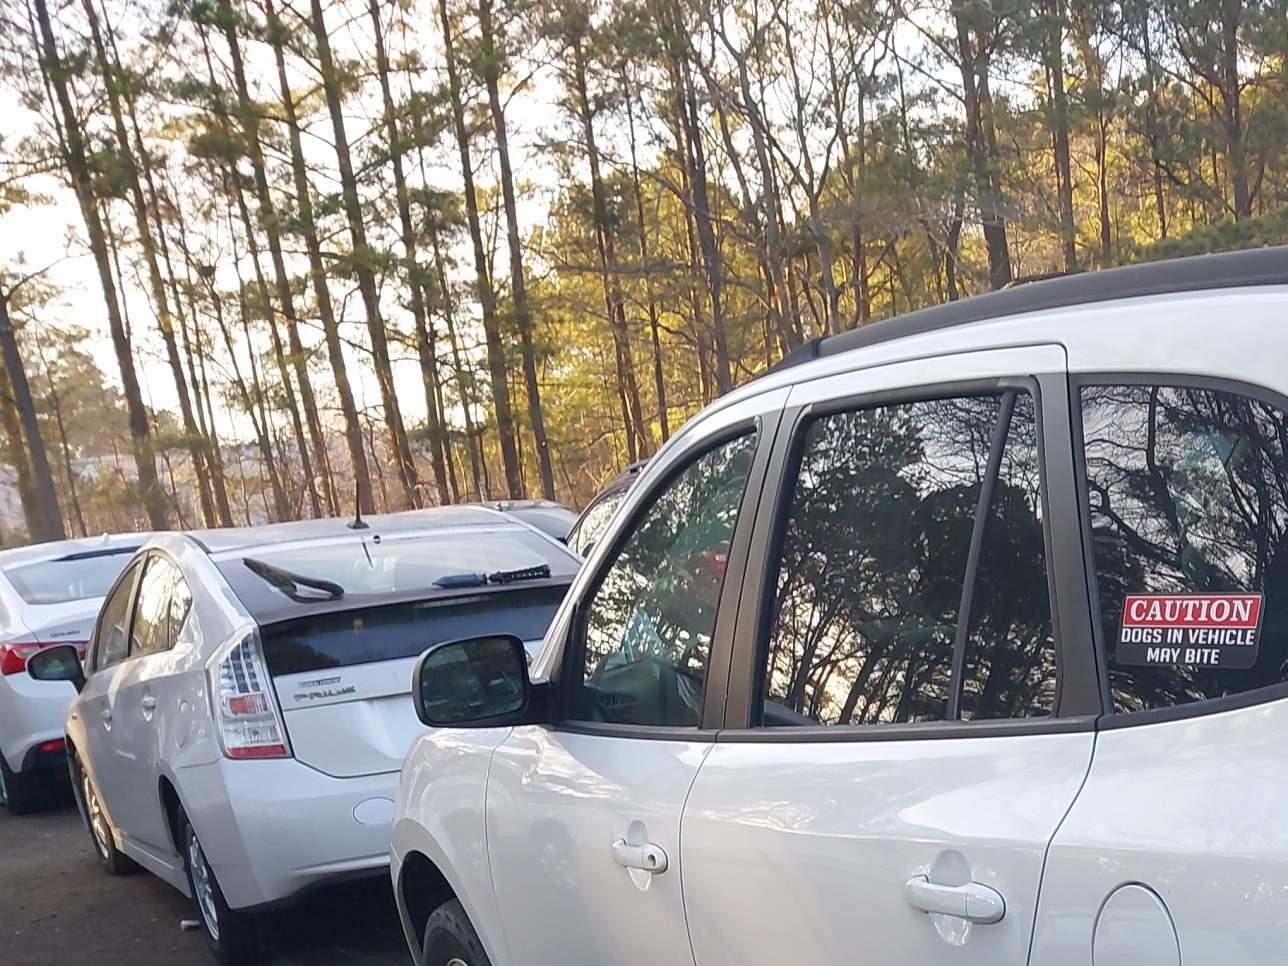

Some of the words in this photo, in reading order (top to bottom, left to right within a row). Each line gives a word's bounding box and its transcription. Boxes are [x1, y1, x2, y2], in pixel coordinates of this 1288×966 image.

[1130, 599, 1253, 622] CAUTION
[1121, 628, 1162, 643] DOGS
[1167, 628, 1183, 643] IN
[1189, 629, 1256, 645] VEHICLE
[1147, 647, 1181, 663] MAY
[1185, 649, 1220, 664] BITE
